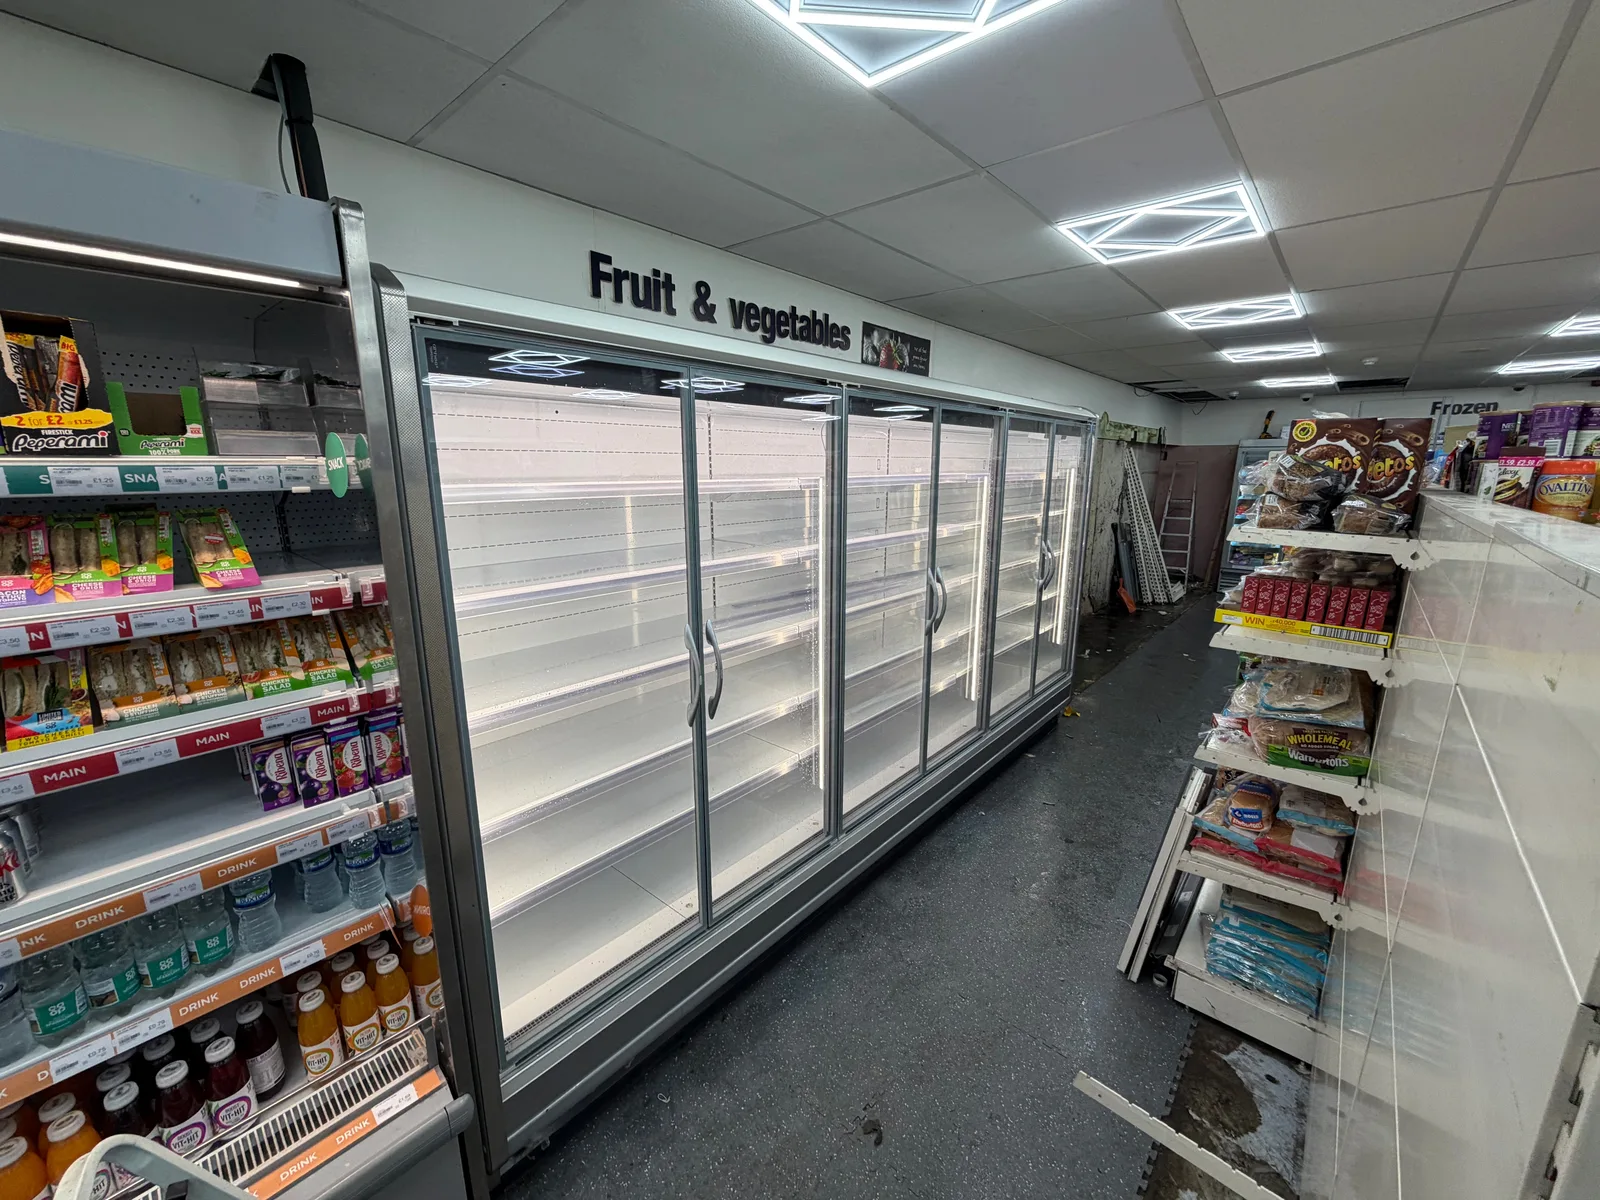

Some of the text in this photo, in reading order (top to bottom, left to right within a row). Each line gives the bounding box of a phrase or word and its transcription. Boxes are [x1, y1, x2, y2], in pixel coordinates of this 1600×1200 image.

[589, 250, 851, 351] Fruit & vegetables
[61, 341, 76, 351] BIG
[1430, 401, 1499, 415] Frozen
[14, 416, 26, 426] 2
[28, 417, 43, 426] for
[46, 415, 65, 426] £2
[12, 430, 109, 452] Peperami
[140, 437, 186, 449] Peperami
[328, 456, 345, 471] SNACK
[124, 473, 157, 484] SNA
[312, 596, 323, 604] IN
[1244, 616, 1265, 625] WIN
[309, 668, 336, 676] CHICKEN
[311, 672, 338, 681] SALAD
[261, 678, 290, 687] CHICKEN
[262, 682, 291, 693] SALAD
[195, 687, 227, 697] CHICKEN
[123, 703, 158, 714] CHICKEN
[317, 704, 345, 717] MAIN
[196, 731, 230, 747] MAIN
[1287, 733, 1353, 751] WHOLEMEAL
[351, 741, 362, 770] Ribena
[274, 752, 288, 781] Ribena
[315, 750, 327, 779] Ribena
[43, 766, 87, 783] MAIN
[217, 857, 257, 878] DRINK
[75, 905, 125, 929] DRINK
[343, 922, 374, 941] DRINK
[239, 966, 276, 989] DRINK
[179, 991, 220, 1017] DRINK
[335, 1118, 371, 1145] DRINK
[280, 1152, 318, 1181] DRINK
